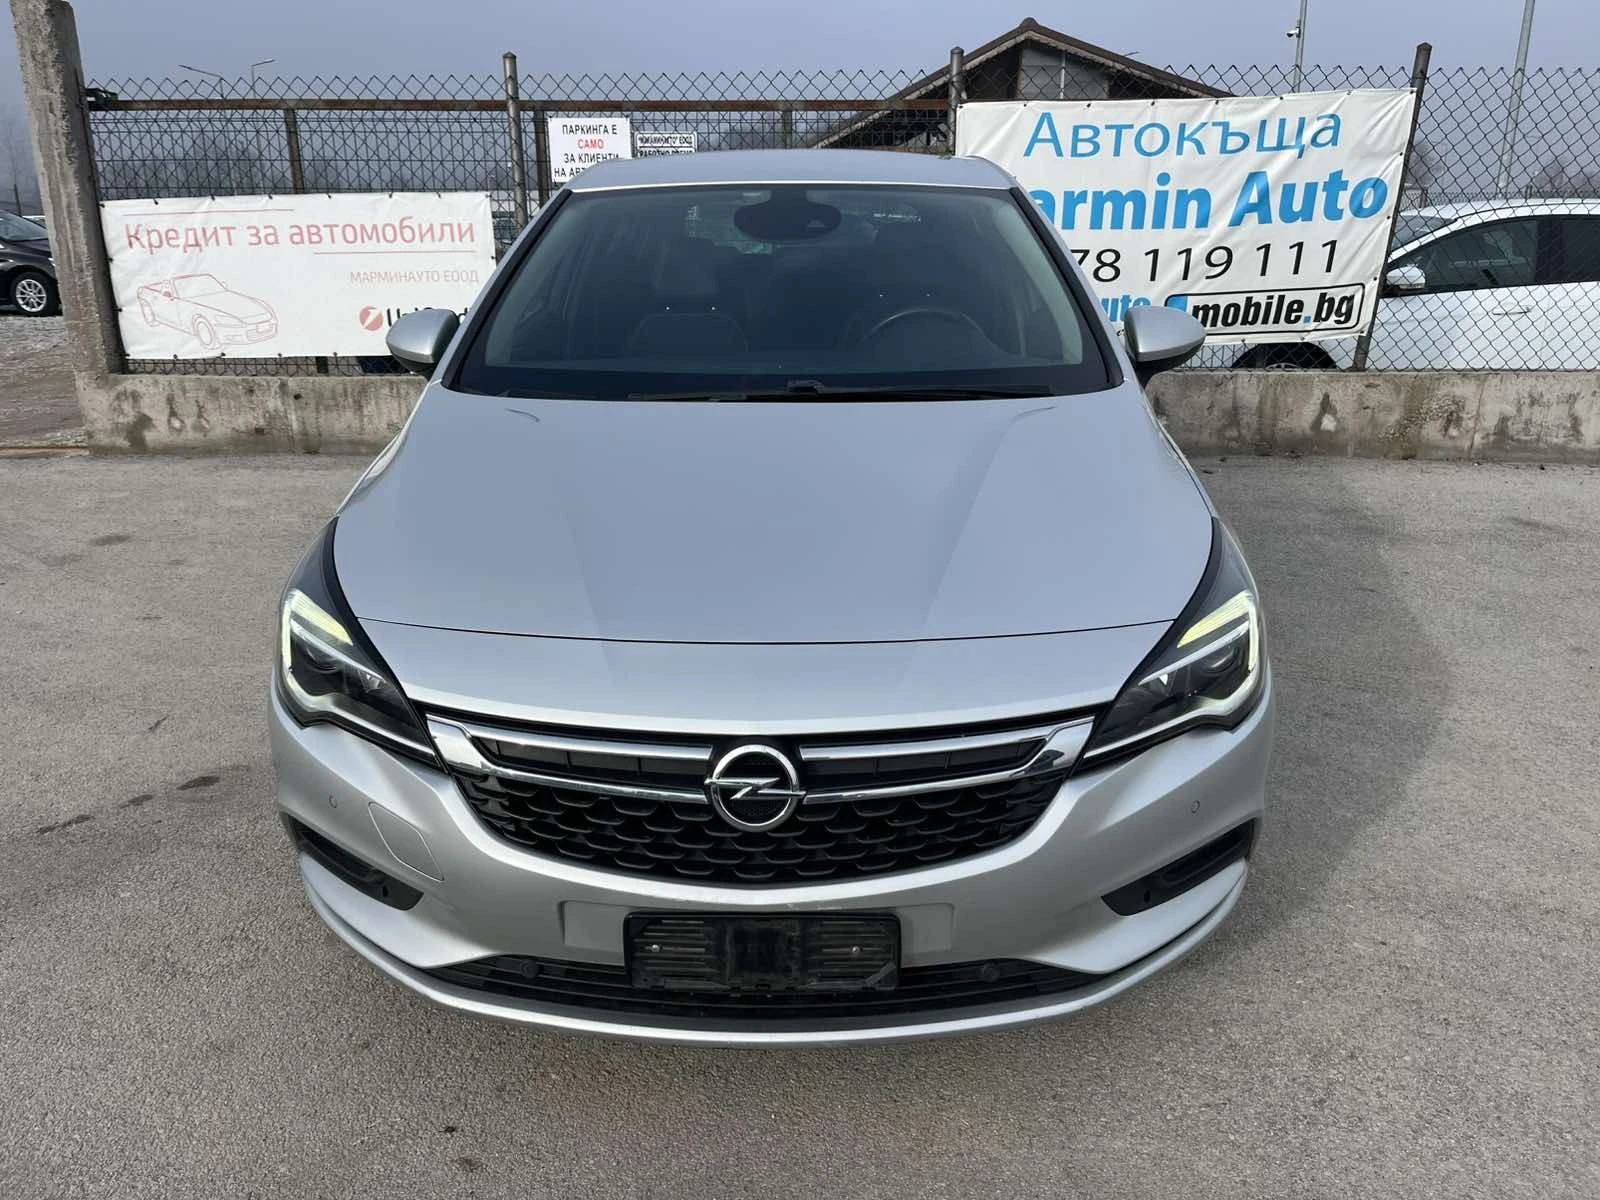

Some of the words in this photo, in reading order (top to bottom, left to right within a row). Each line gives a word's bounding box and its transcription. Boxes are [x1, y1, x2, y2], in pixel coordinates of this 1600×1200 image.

[562, 124, 609, 135] ПАРКИНГА
[611, 124, 618, 135] Е
[1023, 111, 1342, 159] Автокъща
[577, 138, 604, 149] САМО
[564, 153, 576, 164] ЗА
[554, 167, 567, 178] НА
[1029, 171, 1212, 231] armin
[1229, 168, 1389, 227] Auto
[124, 222, 236, 256] Кредит
[247, 222, 280, 246] за
[289, 215, 476, 246] автомобили
[1144, 244, 1234, 282] 119
[1255, 238, 1339, 278] 111
[349, 270, 440, 285] МАРМИНАУТО
[443, 269, 480, 285] ЕООД
[1191, 291, 1355, 329] mobile.bg
